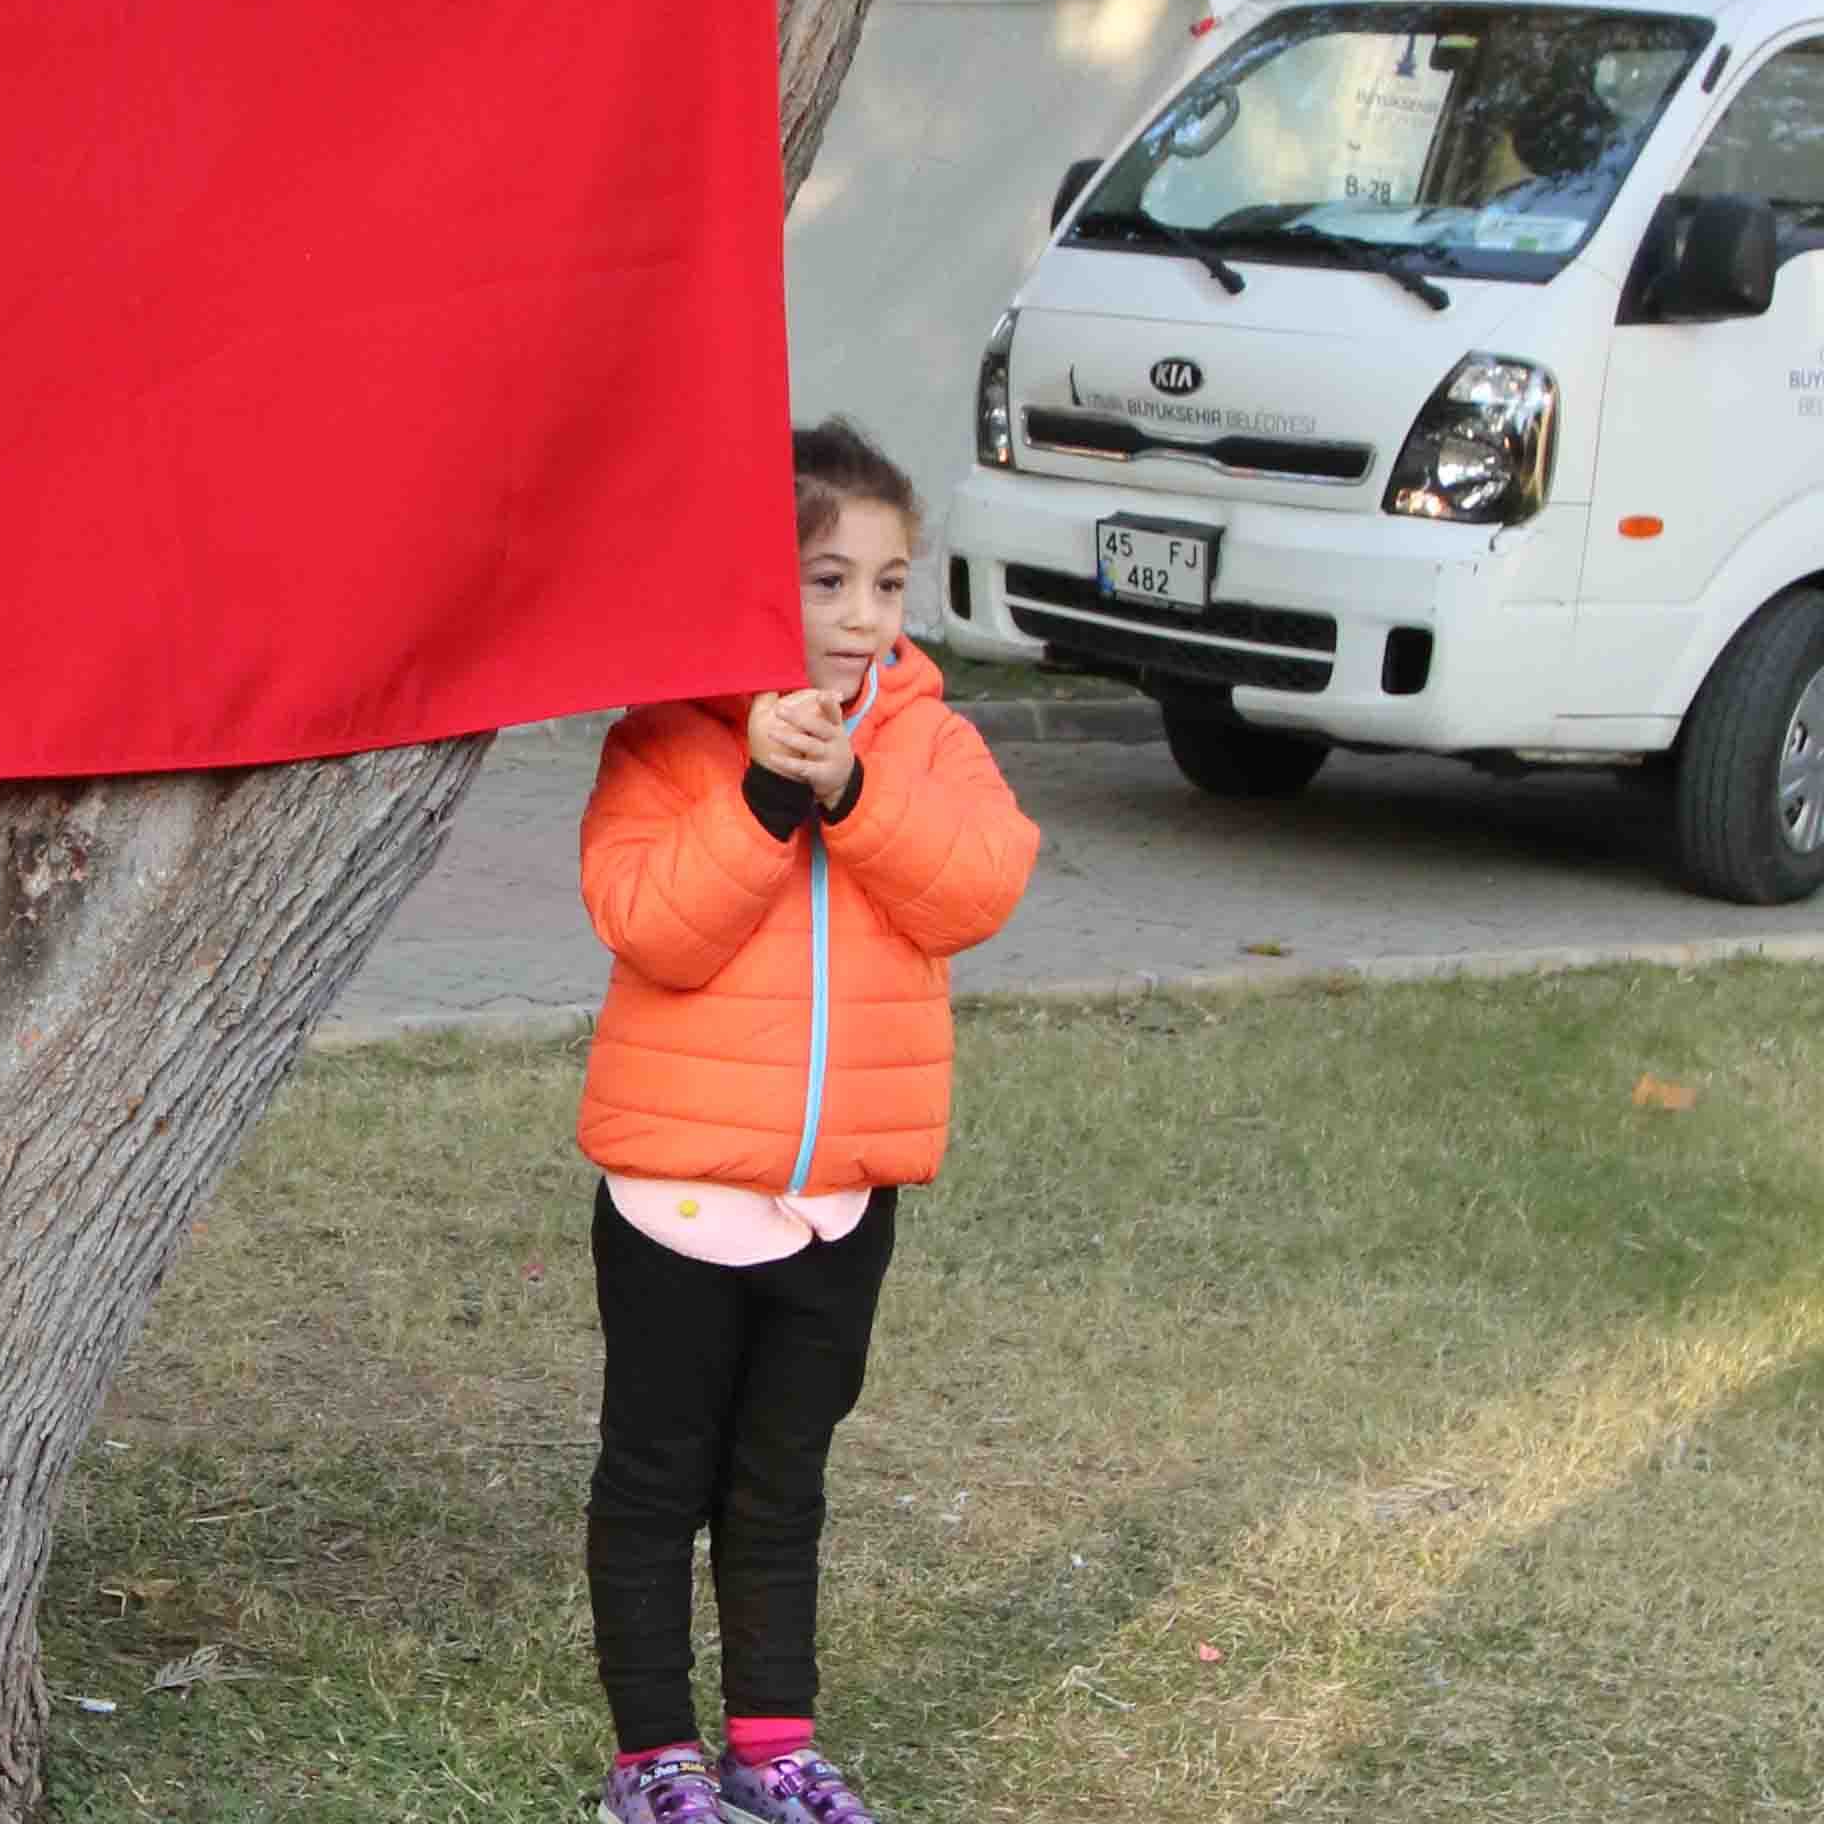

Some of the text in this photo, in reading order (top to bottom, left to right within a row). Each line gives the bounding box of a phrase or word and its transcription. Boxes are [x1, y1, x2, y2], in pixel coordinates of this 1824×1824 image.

[1154, 363, 1194, 388] KIA
[1105, 532, 1197, 569] 45 FJ
[1127, 564, 1169, 594] 482
